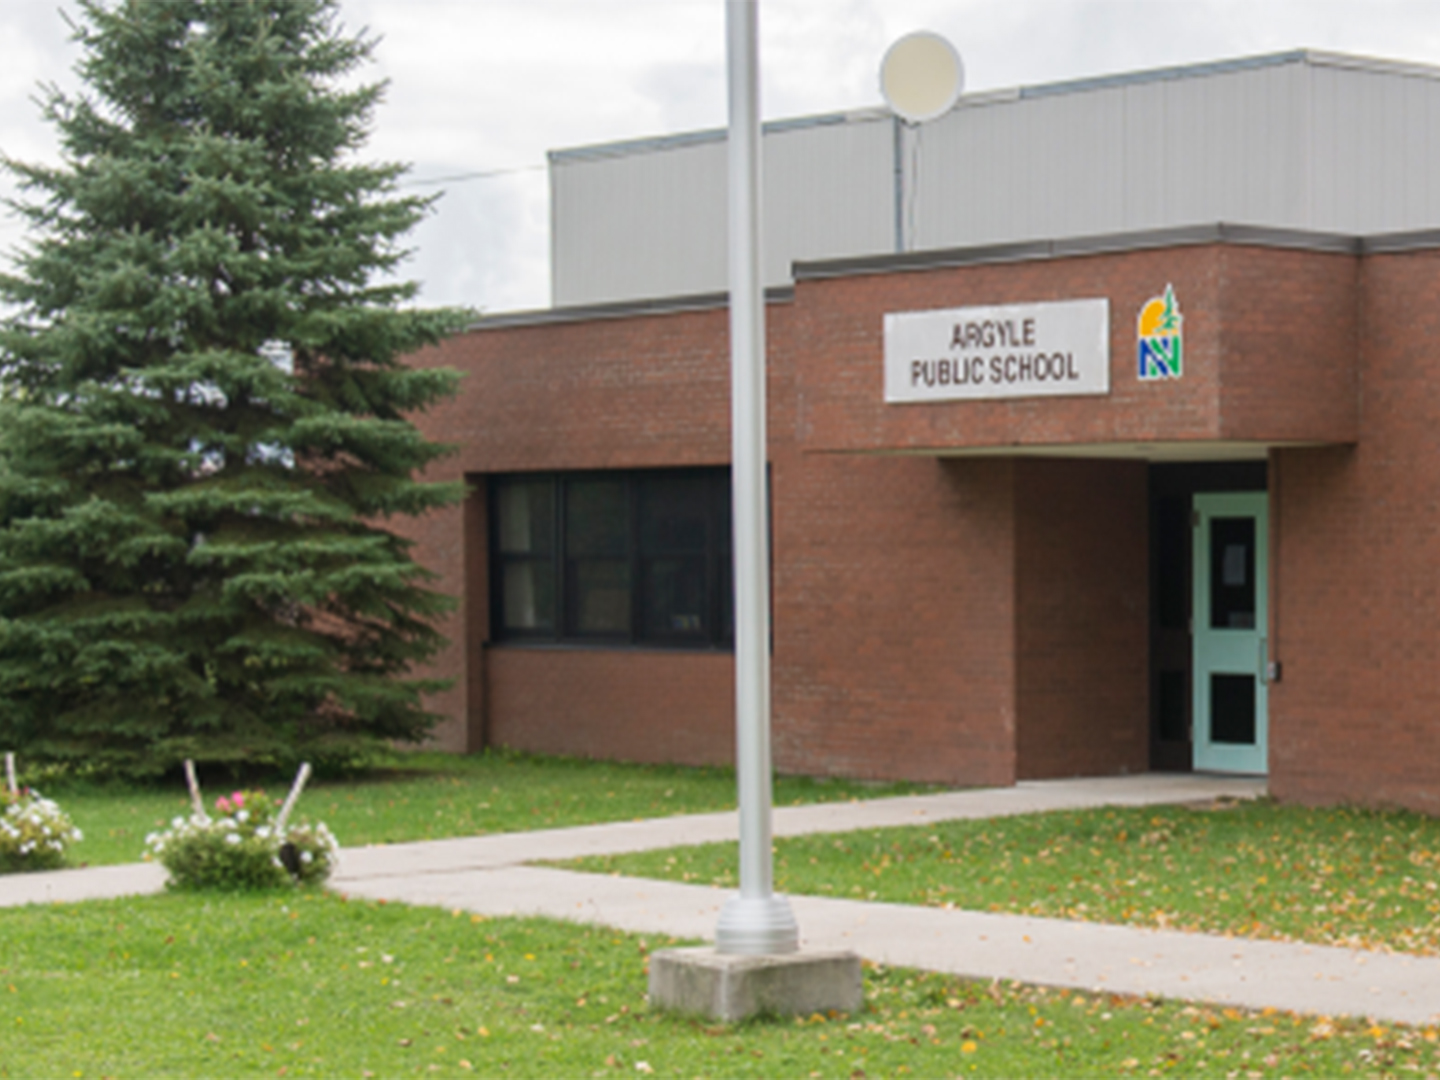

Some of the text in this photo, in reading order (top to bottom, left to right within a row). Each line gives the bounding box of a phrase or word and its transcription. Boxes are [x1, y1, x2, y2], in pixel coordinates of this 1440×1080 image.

[951, 319, 1035, 350] ARGYLE
[911, 352, 1079, 387] PUBLIC SCHOOL
